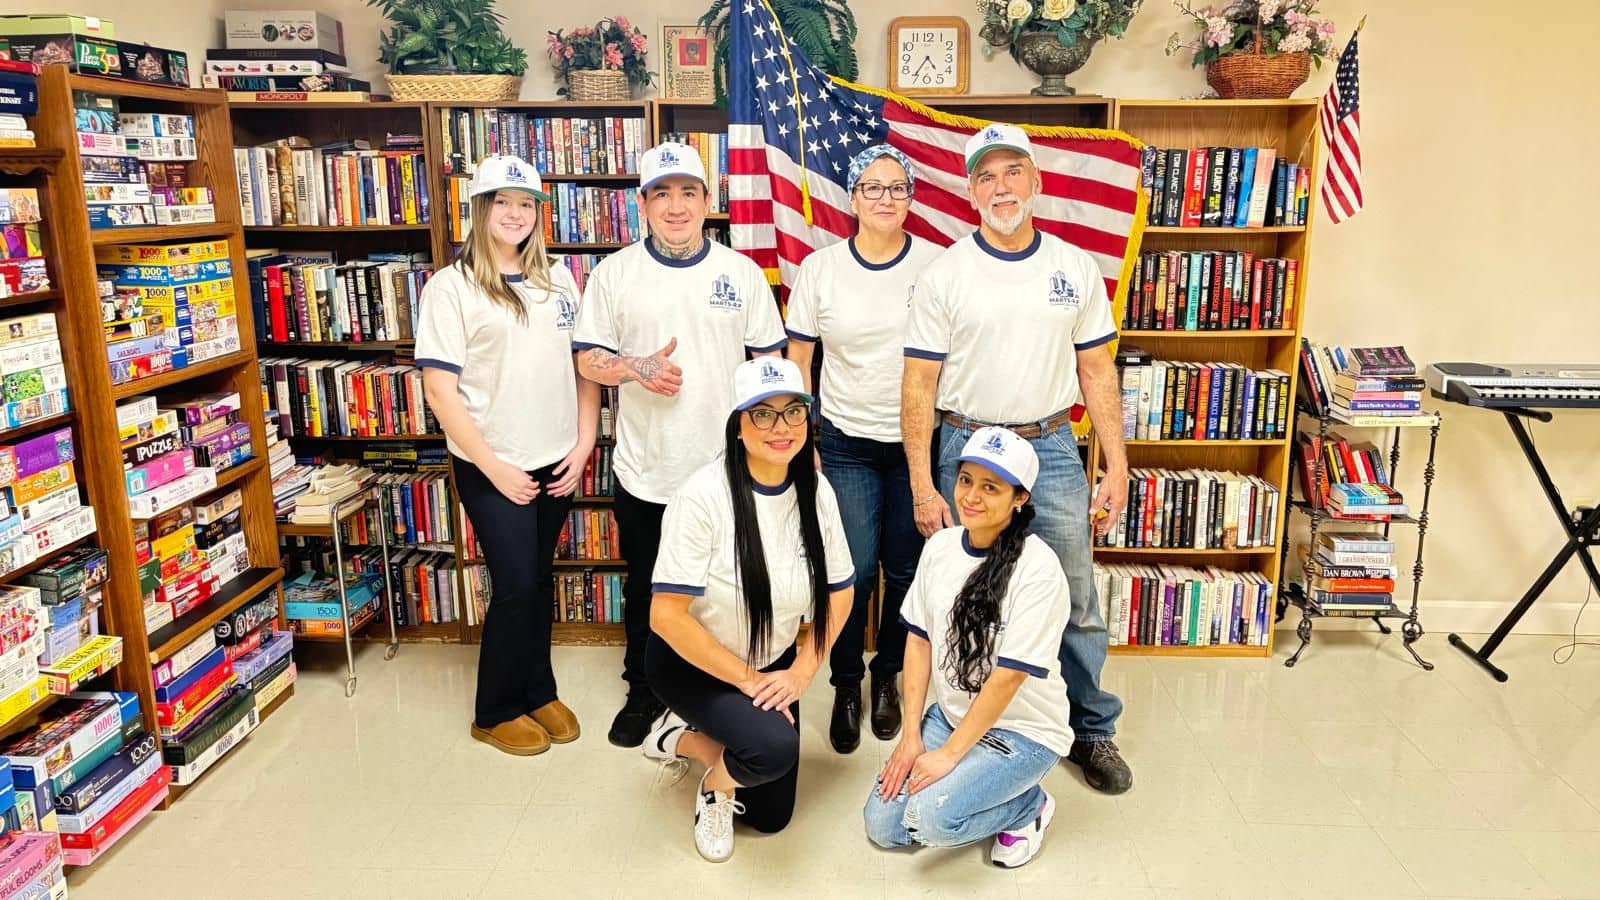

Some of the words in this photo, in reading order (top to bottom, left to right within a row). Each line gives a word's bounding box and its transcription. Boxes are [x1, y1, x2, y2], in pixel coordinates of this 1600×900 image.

[912, 32, 919, 42] 11
[923, 32, 934, 42] 12
[903, 42, 914, 51] 10
[945, 41, 953, 50] 2
[902, 54, 911, 64] 9
[945, 54, 953, 63] 3
[902, 65, 910, 74] 8
[945, 65, 952, 74] 4
[220, 76, 269, 91] UPWORDS
[912, 74, 919, 84] 7
[922, 73, 932, 84] 6
[935, 74, 944, 84] 5
[259, 92, 305, 101] MONOPOLY
[1216, 151, 1224, 165] TOM
[1194, 168, 1202, 190] CLANCY
[1213, 168, 1222, 192] CLANCY
[139, 247, 160, 259] 1000
[139, 267, 162, 279] 1000
[145, 289, 167, 298] 1000
[138, 438, 172, 461] PUZZLE
[1323, 569, 1340, 577] DAN
[1340, 568, 1366, 577] BROWN
[317, 607, 338, 616] 1500
[323, 622, 341, 630] 1000
[94, 714, 113, 736] 1000
[130, 736, 155, 762] 1000
[16, 860, 43, 887] BLOOMS
